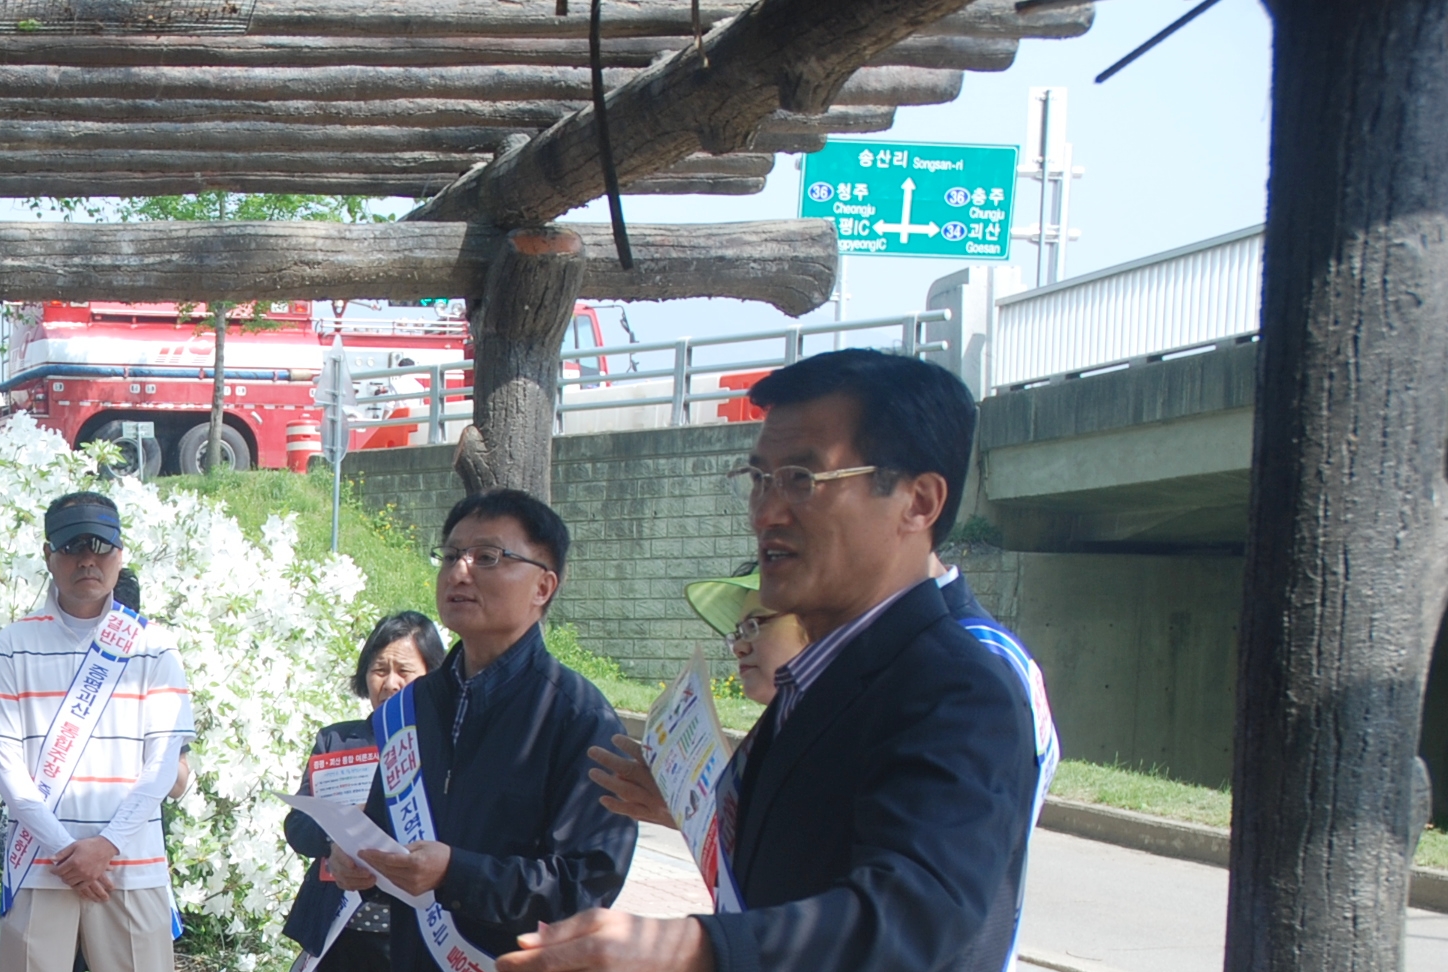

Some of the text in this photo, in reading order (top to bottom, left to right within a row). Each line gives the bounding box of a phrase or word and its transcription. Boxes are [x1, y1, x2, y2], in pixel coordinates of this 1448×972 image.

[857, 148, 964, 172] 송산리 Songsan-ri
[811, 182, 869, 202] 36 청주
[948, 187, 1005, 207] 36 충주
[833, 201, 876, 218] Cheongju
[969, 206, 1006, 222] Chungju
[945, 222, 1001, 241] 34 괴산
[966, 241, 1001, 254] Goesan
[107, 614, 138, 641] 결사
[99, 630, 134, 654] 반대
[70, 663, 109, 720] 증평괴산
[43, 721, 79, 779] 통합주장
[381, 732, 414, 770] 결사
[386, 750, 418, 790] 반대
